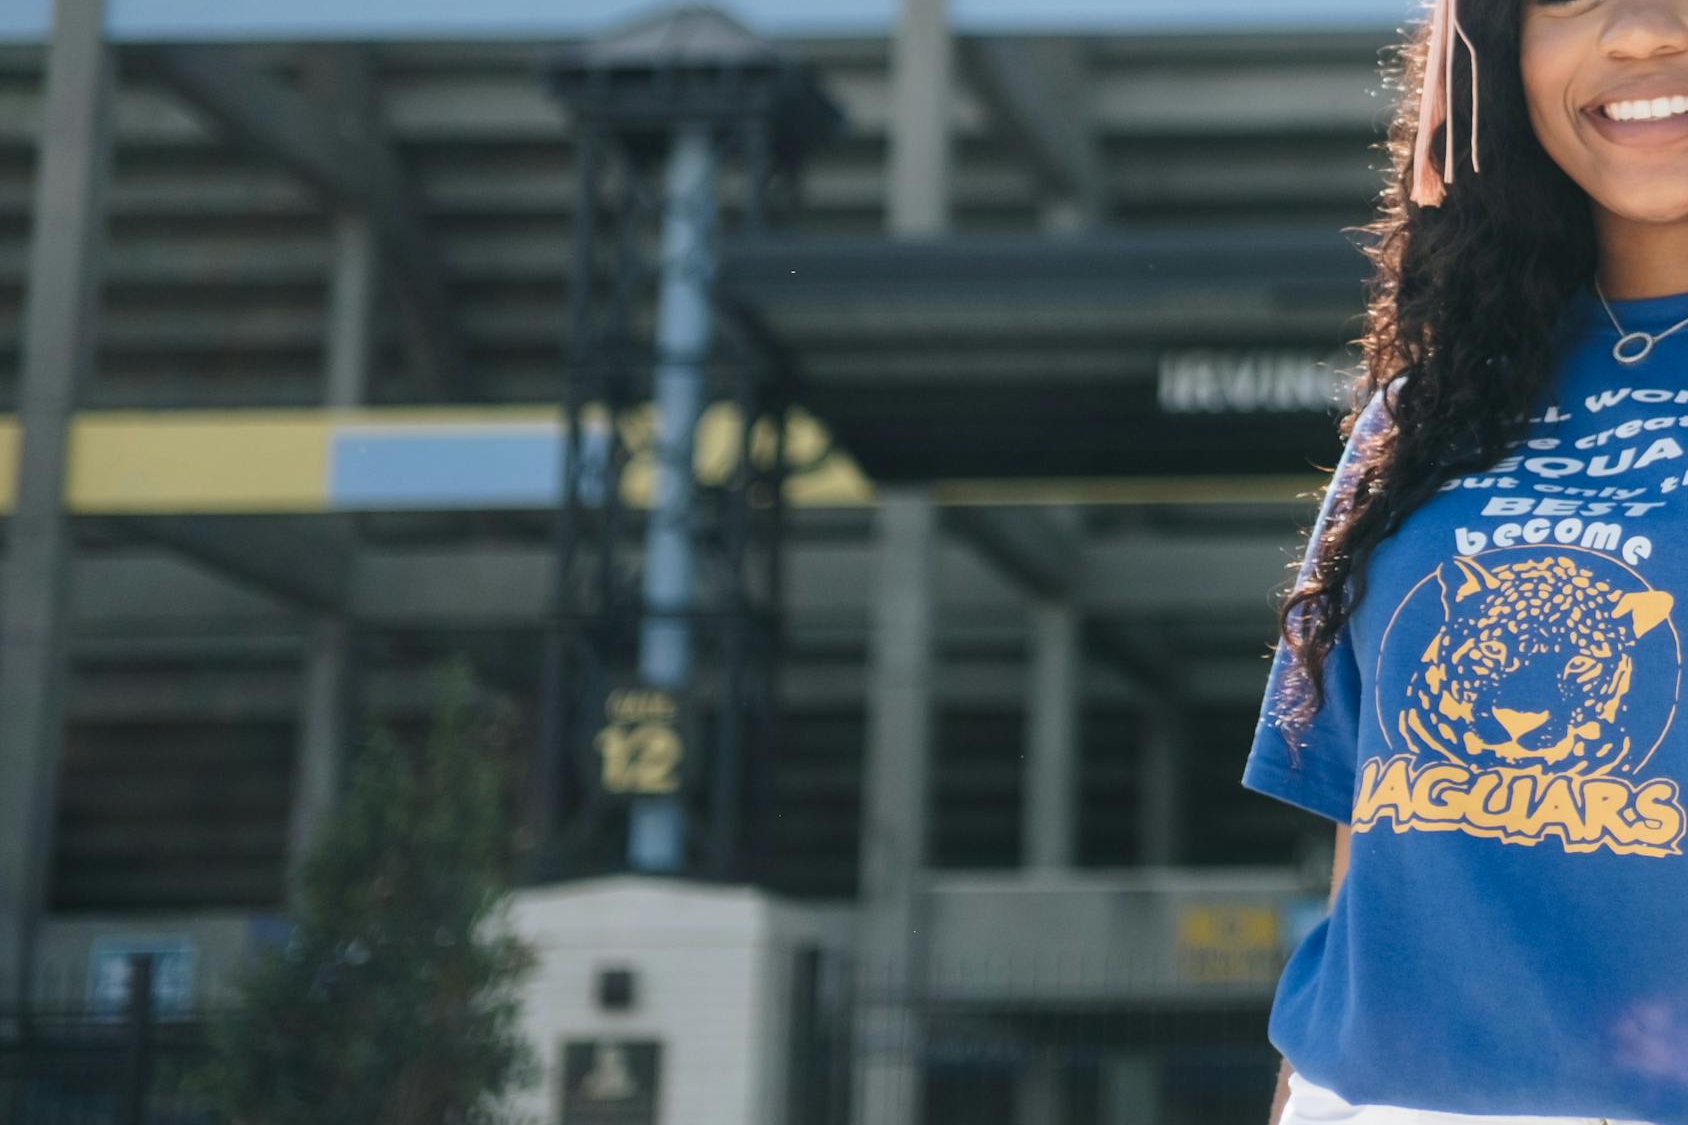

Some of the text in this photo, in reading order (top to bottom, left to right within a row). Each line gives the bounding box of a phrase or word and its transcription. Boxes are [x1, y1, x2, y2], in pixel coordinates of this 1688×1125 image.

[1480, 496, 1667, 517] BEST
[1532, 483, 1648, 500] only
[1455, 518, 1652, 566] become
[593, 724, 683, 793] 12
[1351, 754, 1687, 858] JAGUARS
